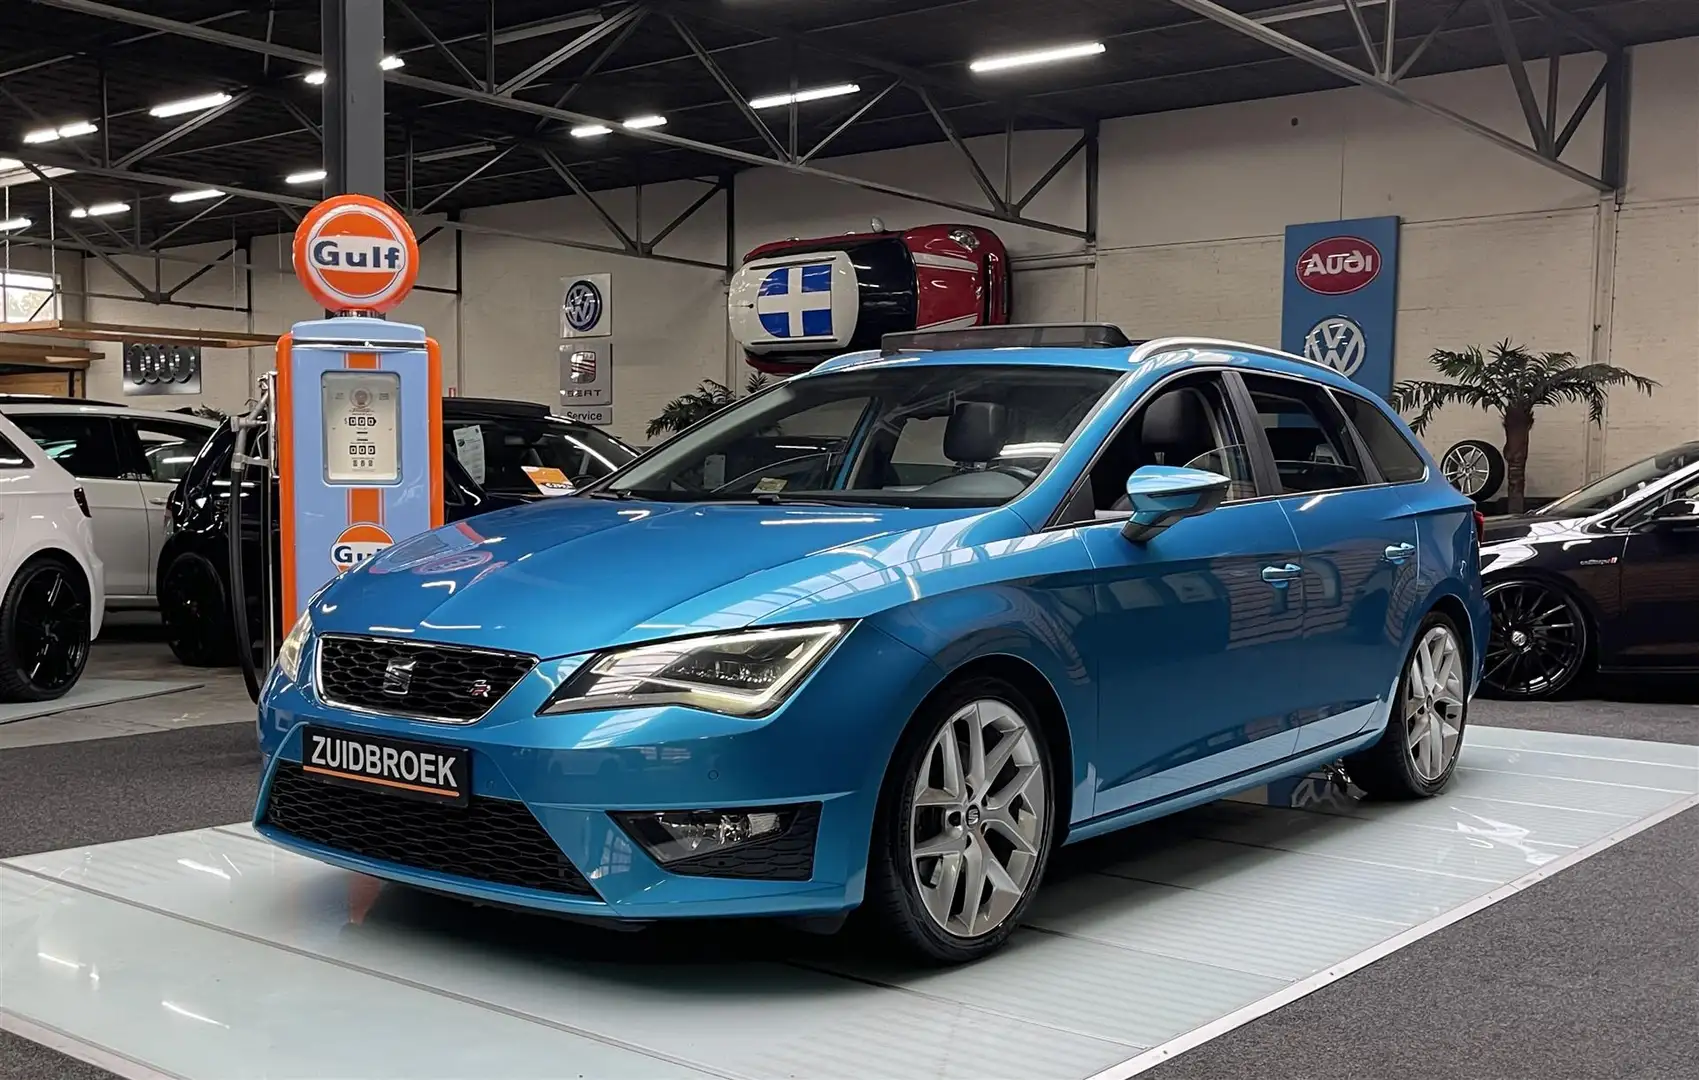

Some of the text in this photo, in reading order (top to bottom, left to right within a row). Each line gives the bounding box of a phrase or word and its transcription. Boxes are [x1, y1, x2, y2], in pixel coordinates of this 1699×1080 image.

[313, 240, 400, 269] Gulf
[566, 410, 602, 421] Service
[311, 735, 457, 788] ZUIDBROEK
